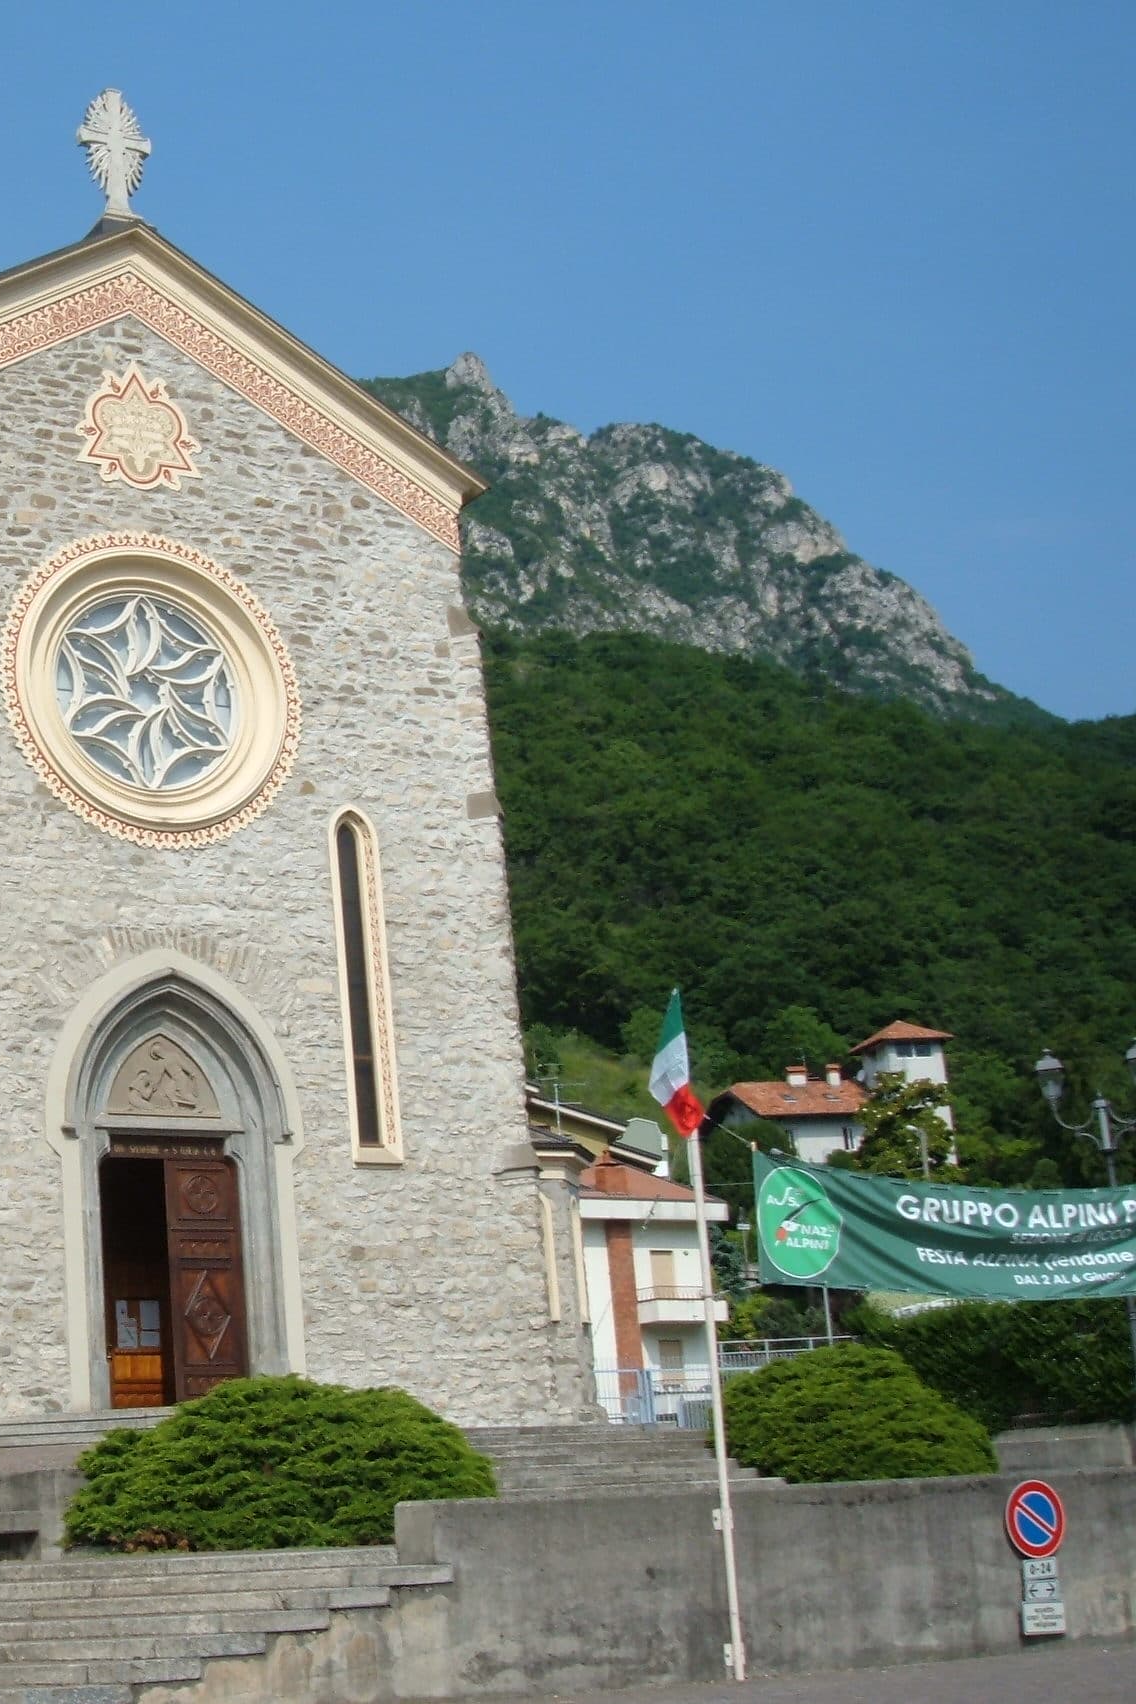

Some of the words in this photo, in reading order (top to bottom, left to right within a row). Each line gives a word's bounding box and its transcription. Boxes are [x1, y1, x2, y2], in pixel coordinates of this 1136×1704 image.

[896, 1195, 1020, 1228] GRUPPO
[1028, 1203, 1117, 1229] ALPINI
[786, 1237, 829, 1250] ALPINI
[1009, 1232, 1070, 1245] SEZIONE
[916, 1247, 968, 1265] FESTA
[972, 1252, 1039, 1267] ALPINA
[1014, 1275, 1037, 1286] DAL
[1041, 1275, 1051, 1285] 2
[1053, 1273, 1070, 1285] AL
[1030, 1562, 1051, 1575] 0-24
